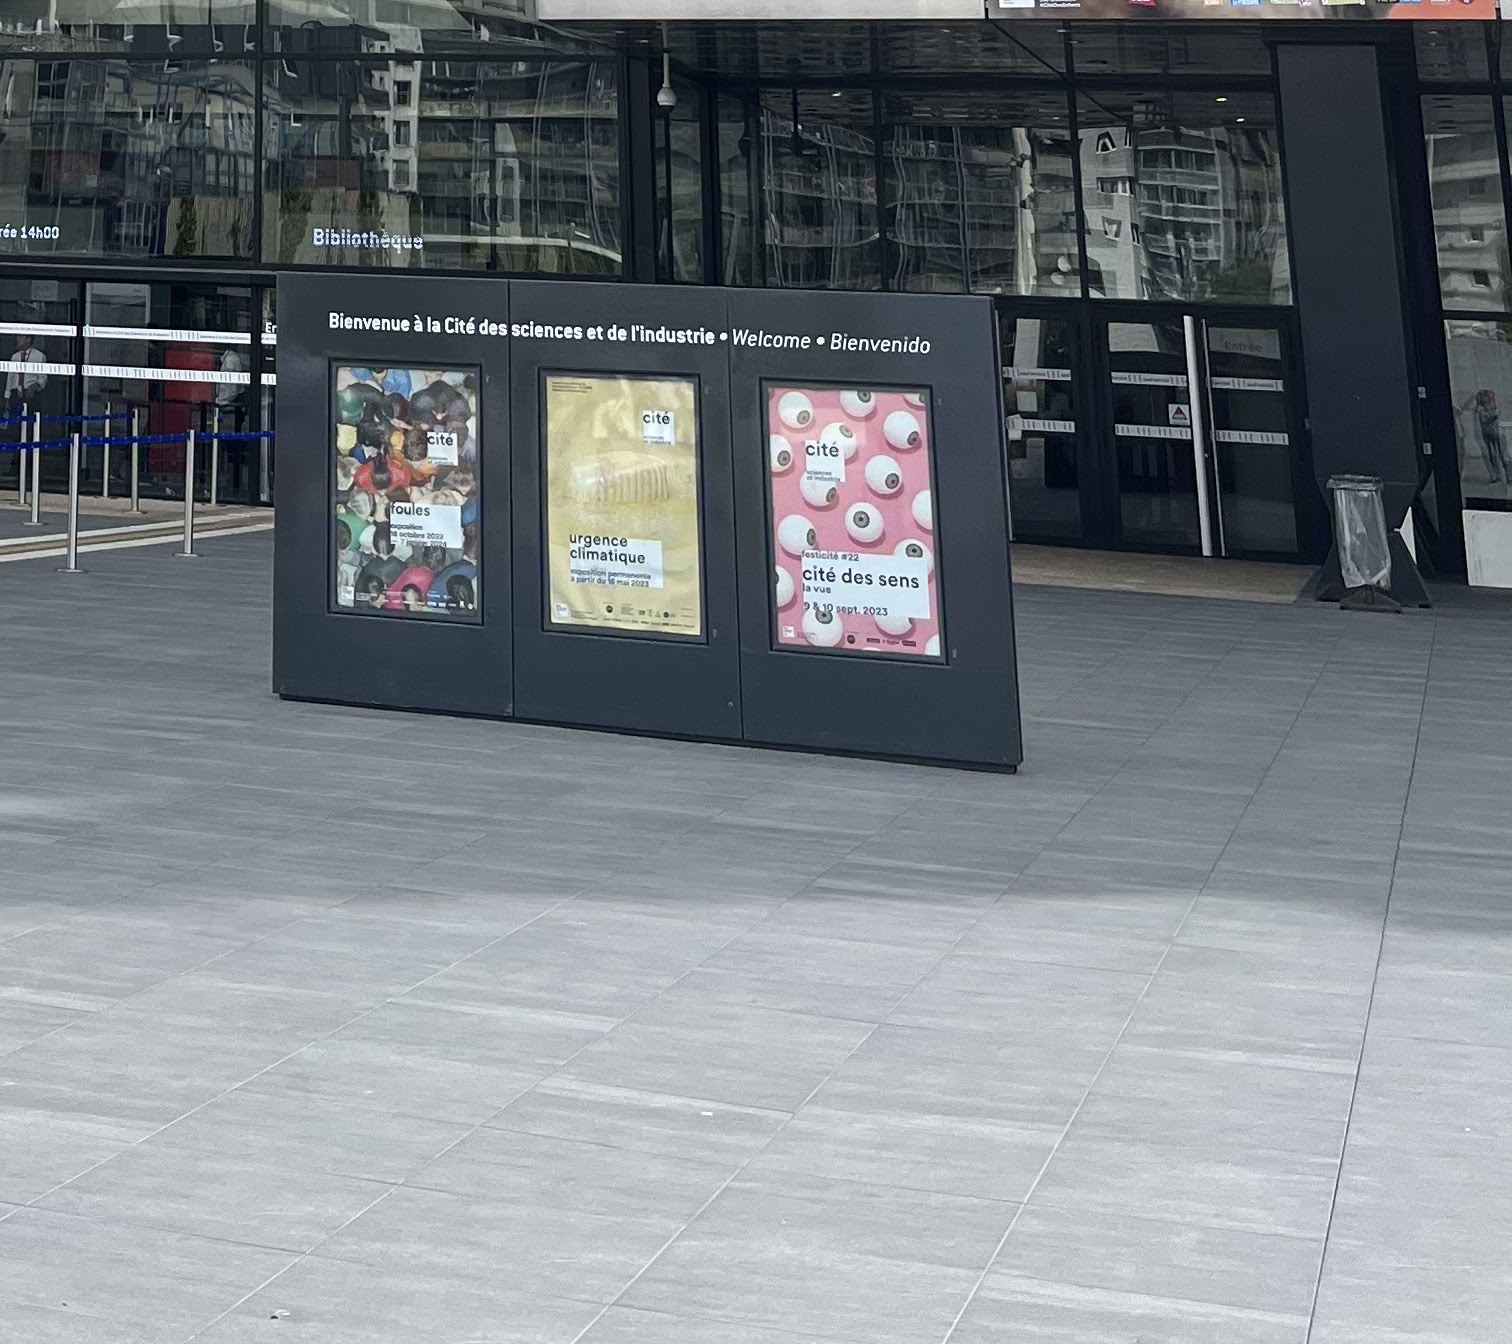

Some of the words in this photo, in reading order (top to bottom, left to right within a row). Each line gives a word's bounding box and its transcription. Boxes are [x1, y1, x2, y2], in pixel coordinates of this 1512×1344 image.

[20, 225, 60, 240] 14h00
[313, 226, 424, 255] Bibliothèque
[328, 312, 410, 332] Bienvenue
[413, 314, 424, 332] à
[426, 316, 441, 333] la
[444, 316, 476, 335] Cité
[478, 319, 508, 337] des
[511, 320, 583, 340] sciences
[586, 324, 604, 341] et
[607, 324, 627, 342] de
[630, 324, 716, 345] l'industrie
[732, 328, 812, 350] Welcome
[830, 332, 932, 355] Bienvenido
[642, 410, 671, 425] cité
[427, 432, 454, 446] cité
[805, 441, 840, 458] cité
[569, 534, 628, 548] urgence
[570, 546, 646, 566] climatique
[801, 549, 839, 560] festicité
[802, 565, 837, 583] cité
[841, 568, 874, 586] des
[878, 575, 920, 589] sens
[802, 582, 811, 593] la
[813, 585, 832, 594] vue
[822, 603, 834, 612] 10
[836, 605, 861, 616] sept.
[862, 606, 888, 617] 2023
